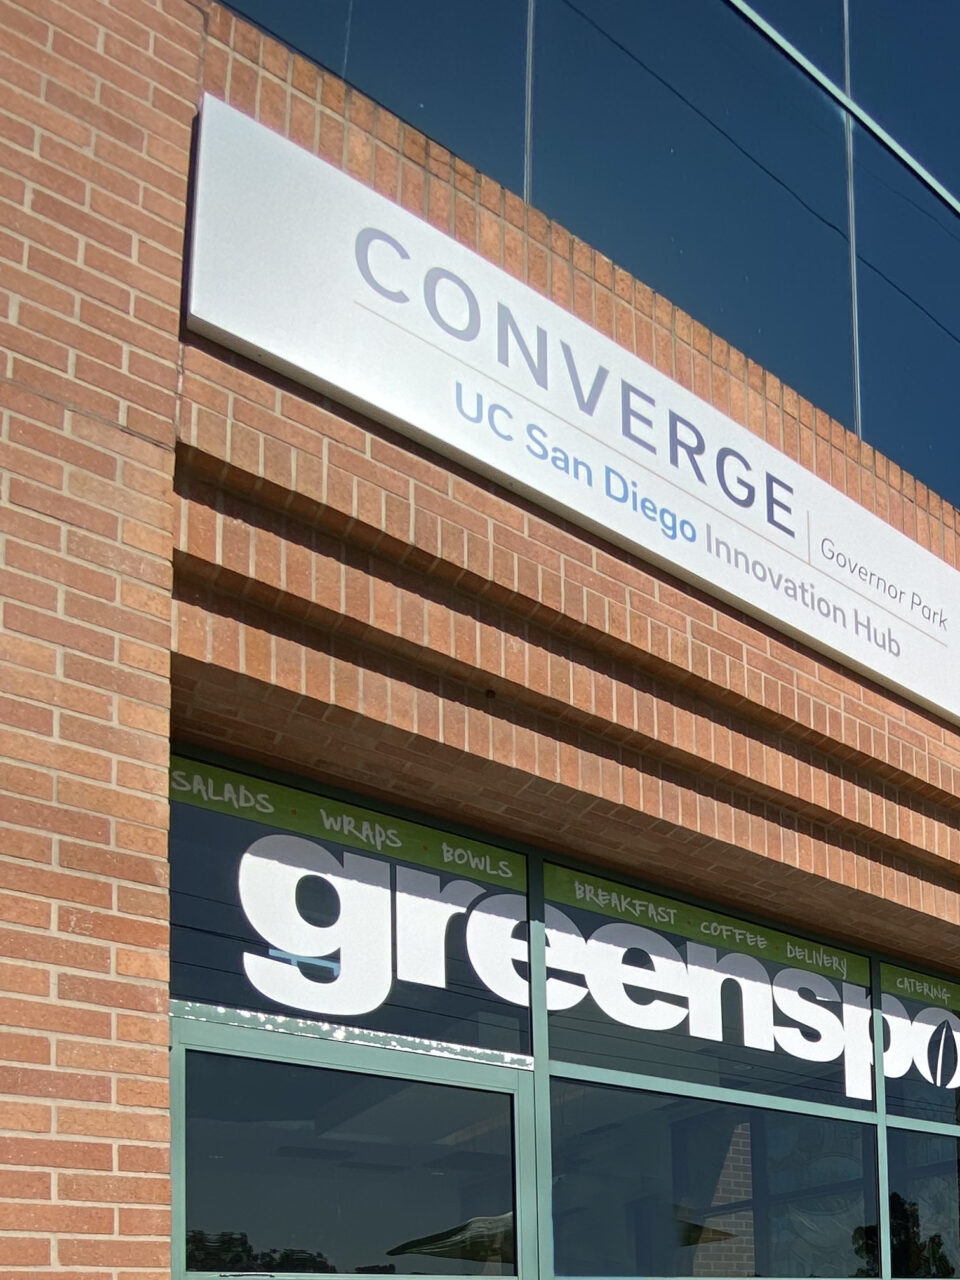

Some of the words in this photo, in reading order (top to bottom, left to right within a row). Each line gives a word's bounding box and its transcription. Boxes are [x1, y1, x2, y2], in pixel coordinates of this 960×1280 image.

[353, 226, 796, 539] CONVERGE
[455, 380, 514, 442] UC
[525, 423, 594, 488] San
[604, 465, 698, 544] Diego
[706, 522, 848, 629] Innovation
[854, 608, 901, 658] Hub
[820, 537, 906, 603] Governor
[910, 591, 948, 631] Park
[170, 770, 275, 814] SALADS
[319, 808, 402, 851] WRAPS
[441, 841, 513, 878] BOWLS
[574, 880, 678, 925] BREAKFAST
[700, 921, 768, 949] COFFEE
[786, 942, 848, 980] DELIVERY
[896, 977, 951, 1006] CATERING
